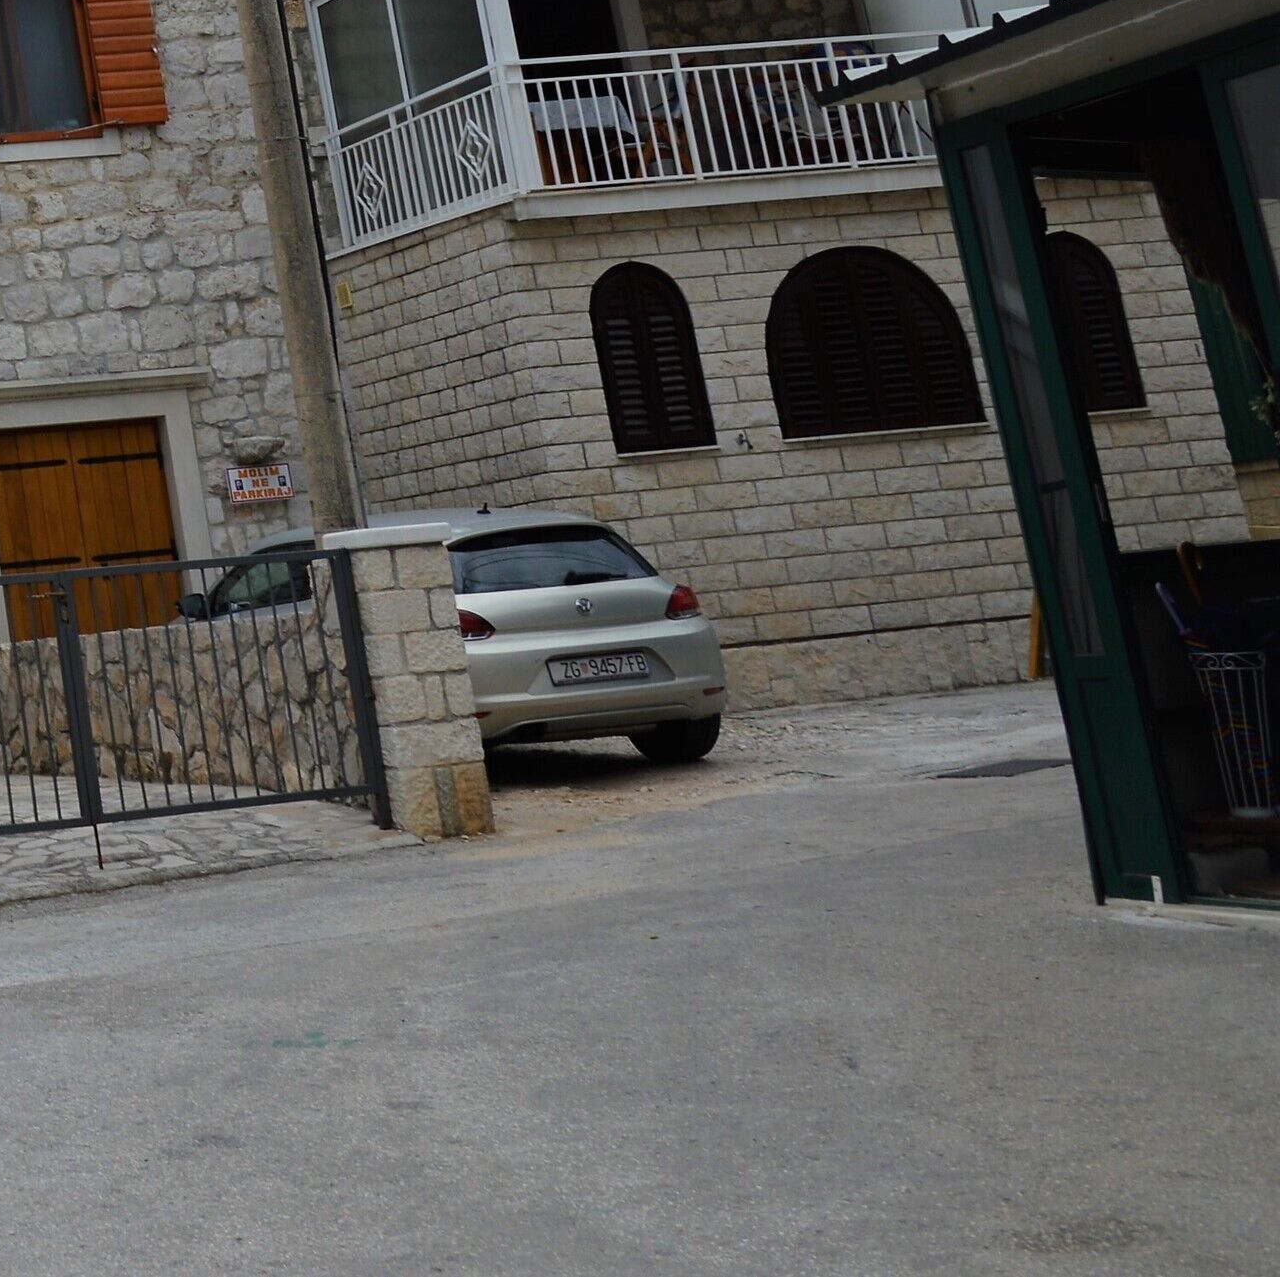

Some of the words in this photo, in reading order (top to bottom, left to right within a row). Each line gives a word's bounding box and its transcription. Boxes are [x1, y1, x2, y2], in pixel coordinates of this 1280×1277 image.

[238, 467, 280, 479] MOLIM
[252, 478, 269, 488] NE
[560, 661, 581, 679] ZG
